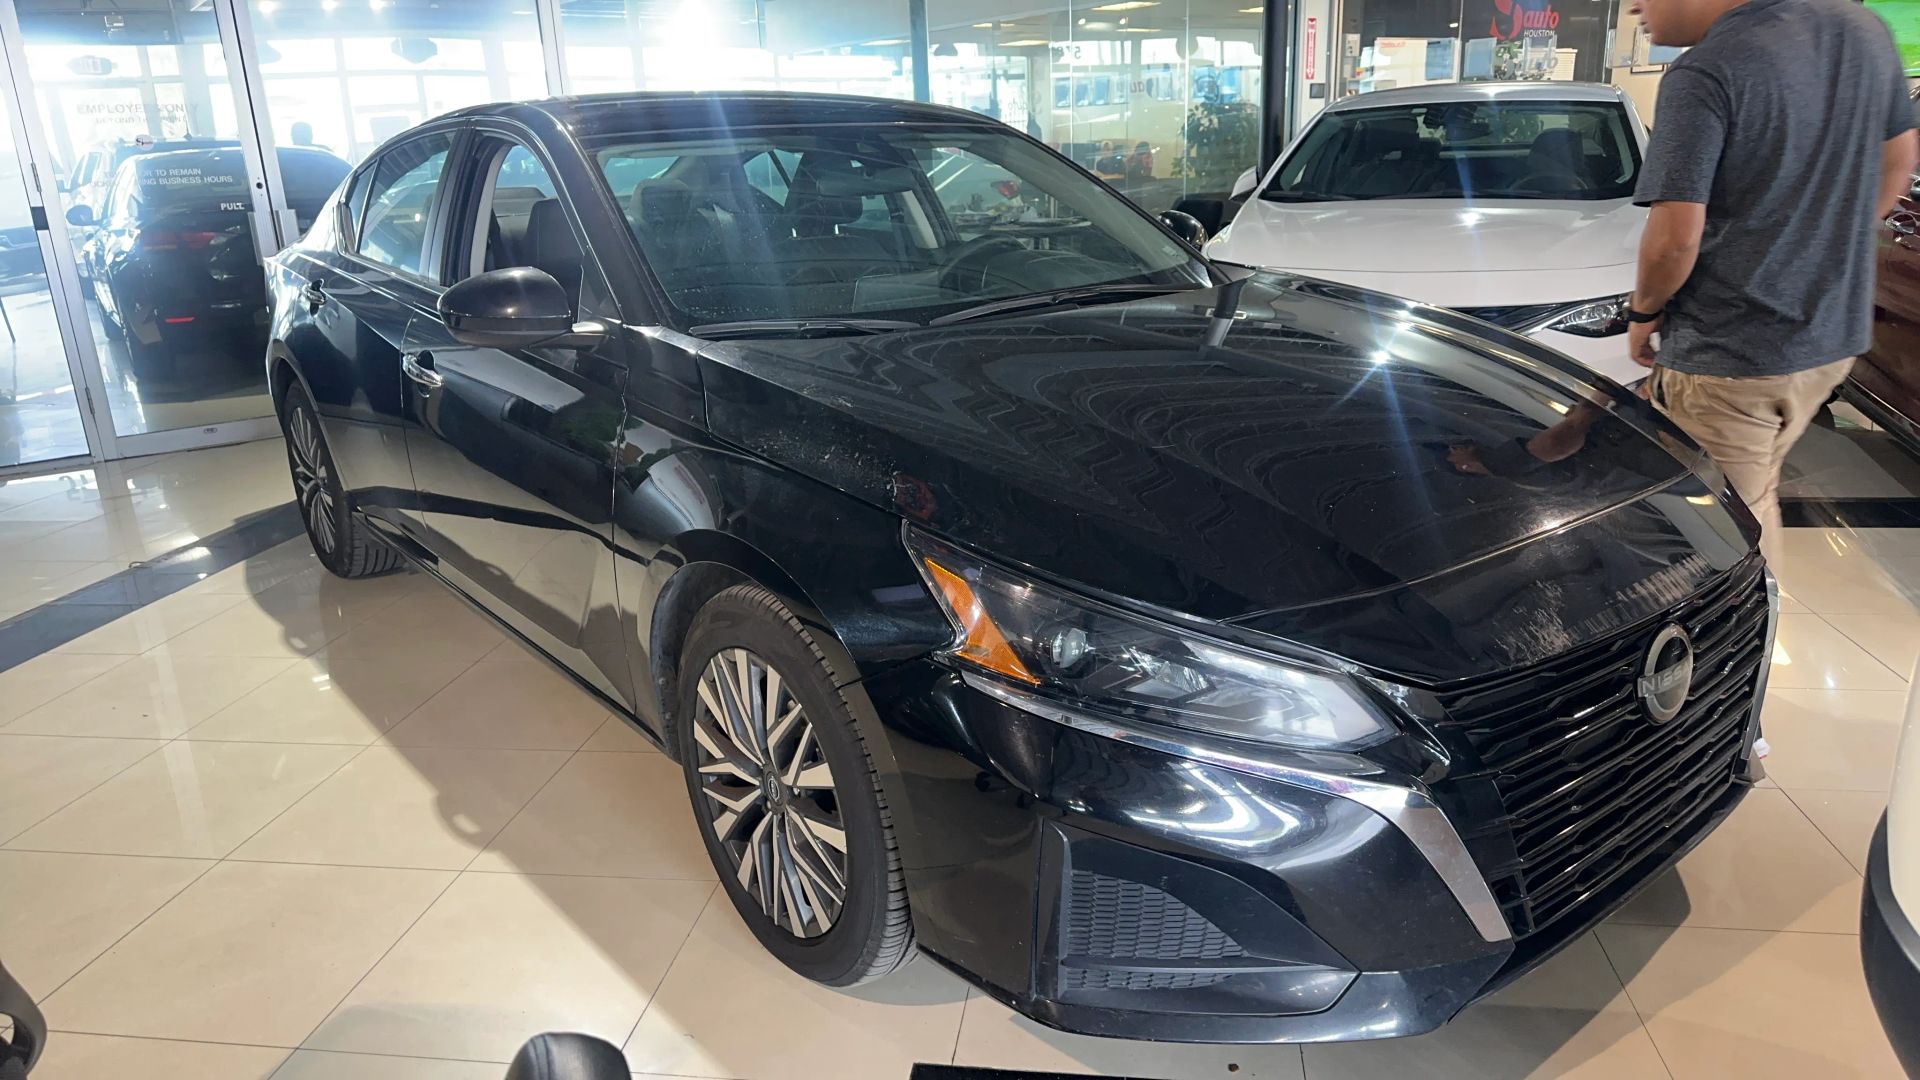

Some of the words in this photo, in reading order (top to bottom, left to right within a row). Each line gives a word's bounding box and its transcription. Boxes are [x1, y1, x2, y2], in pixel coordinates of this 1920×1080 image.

[1524, 5, 1559, 29] auto
[1524, 29, 1556, 38] HOUSTON
[76, 104, 162, 113] EMPLOYE
[156, 169, 167, 177] TO
[169, 168, 201, 176] REMAIN
[159, 176, 202, 185] BUSINESS
[204, 175, 233, 184] HOURS
[220, 202, 245, 211] PULL
[1642, 661, 1689, 694] NISS
